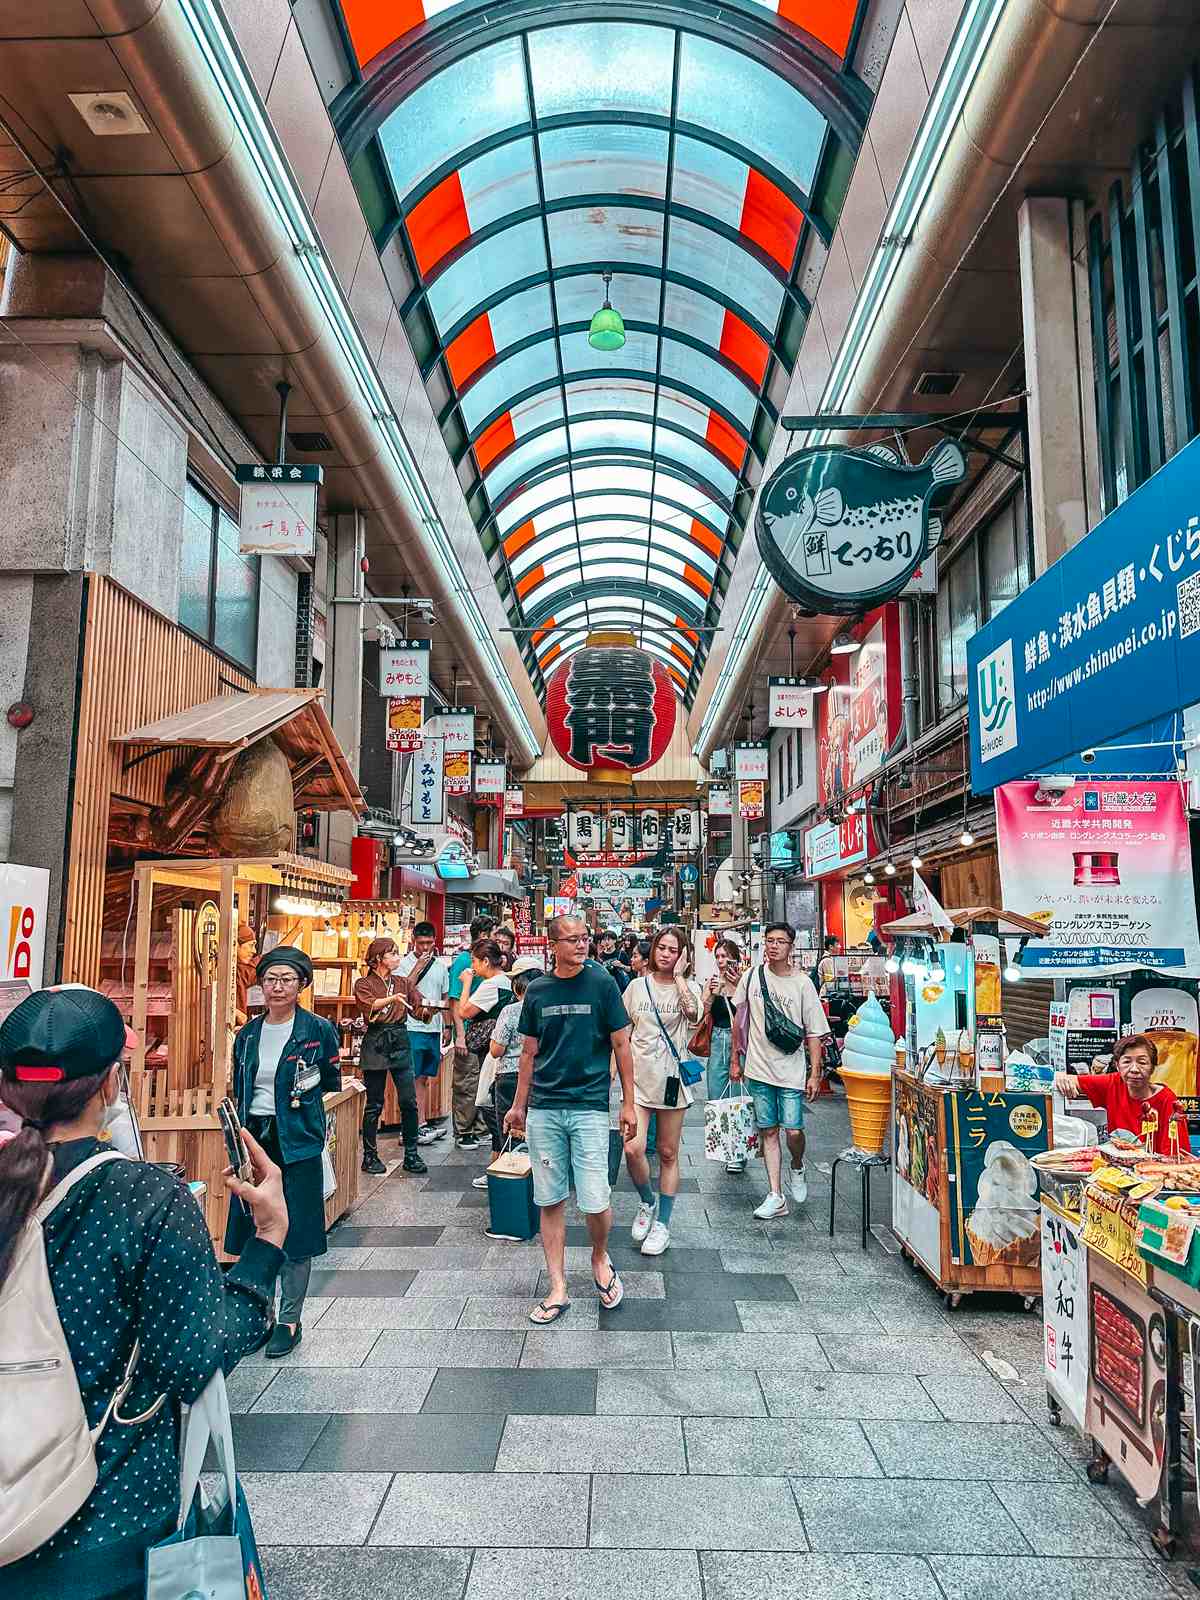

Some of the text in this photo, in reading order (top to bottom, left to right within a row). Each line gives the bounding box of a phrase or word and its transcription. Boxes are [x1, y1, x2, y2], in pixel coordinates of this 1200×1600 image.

[385, 672, 422, 685] みやもと
[1027, 609, 1176, 712] http://www.shinuoei.co.jp
[774, 705, 808, 718] よしや
[420, 763, 435, 819] みやもと
[1054, 1279, 1075, 1378] 和牛
